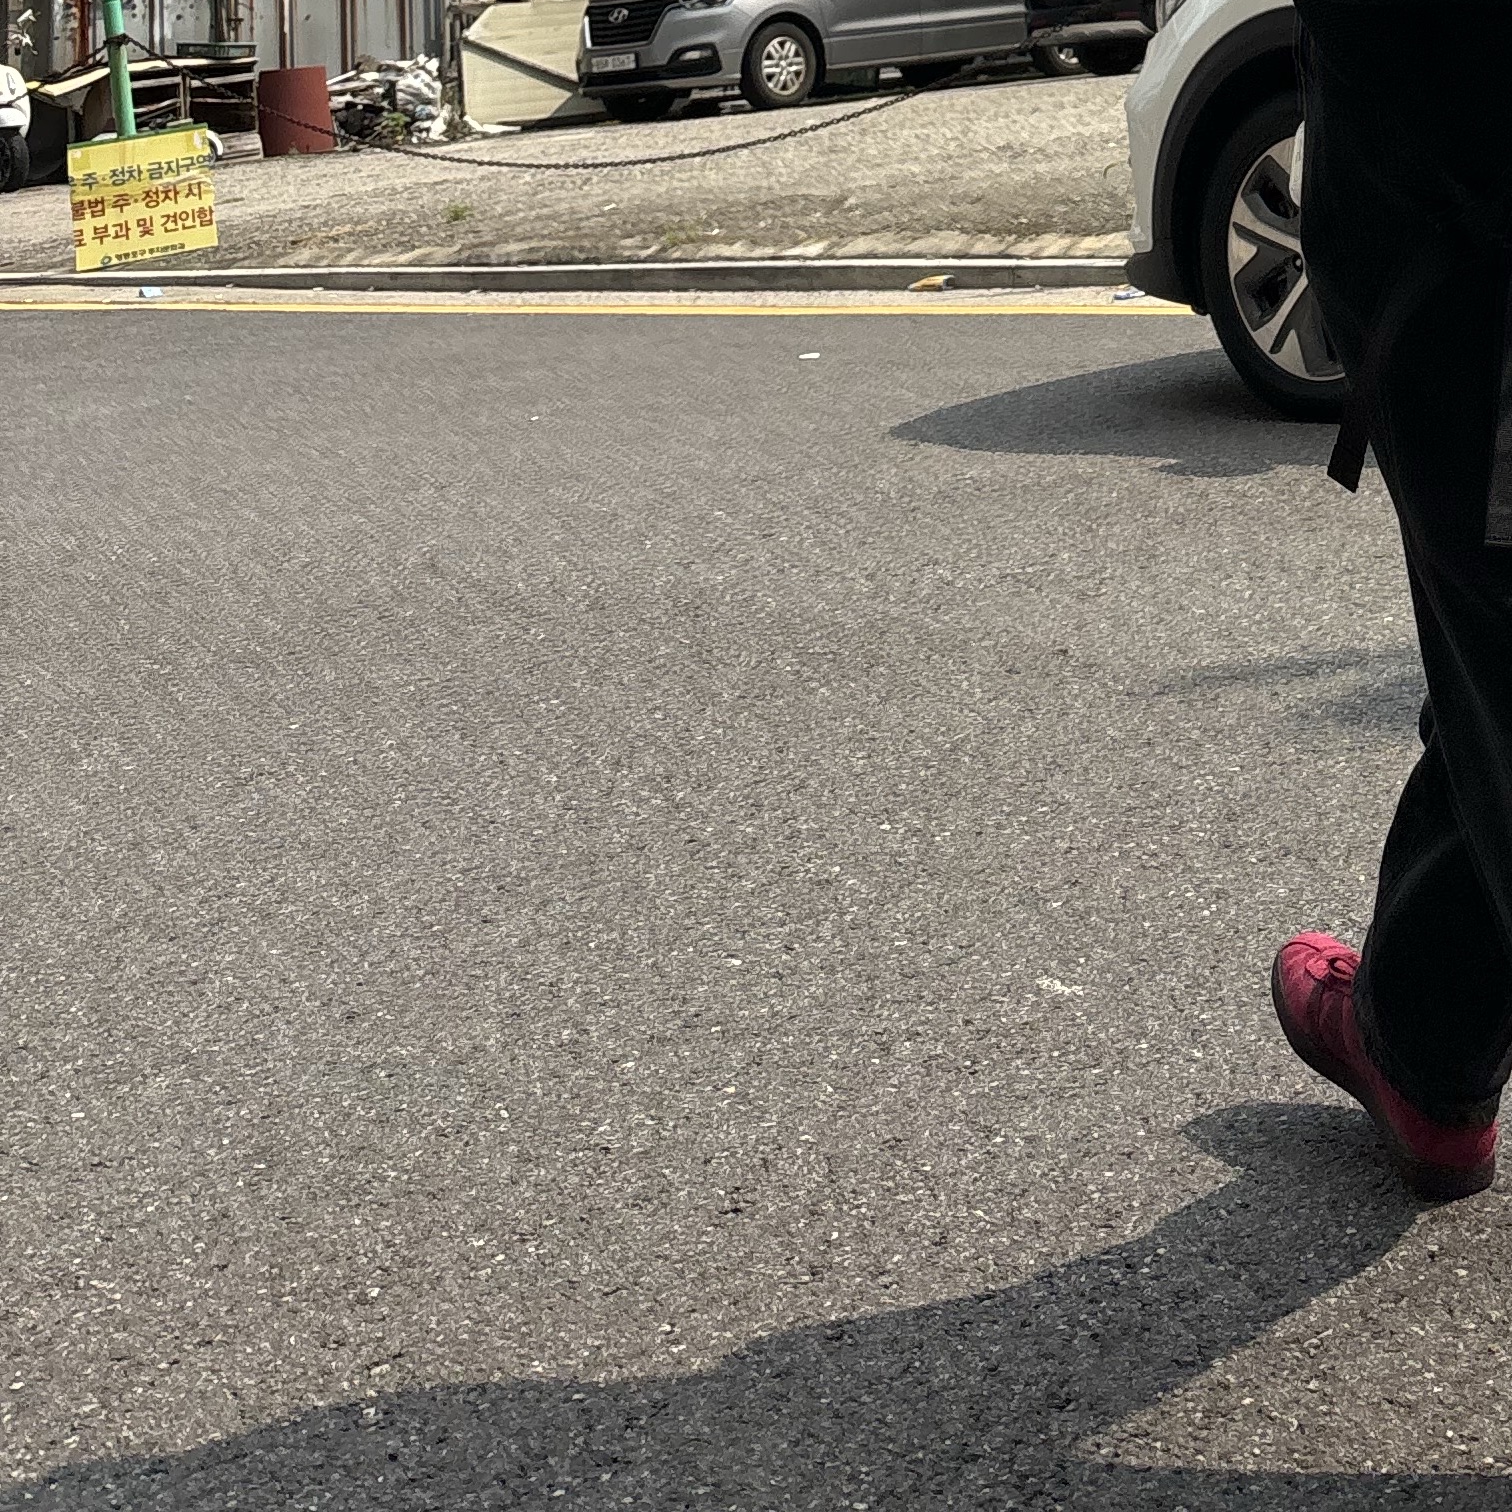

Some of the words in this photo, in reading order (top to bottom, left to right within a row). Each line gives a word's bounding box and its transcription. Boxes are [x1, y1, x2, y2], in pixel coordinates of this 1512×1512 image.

[185, 181, 203, 201] 시
[91, 220, 131, 245] 부과
[136, 216, 154, 237] 및
[160, 205, 215, 233] 견인합
